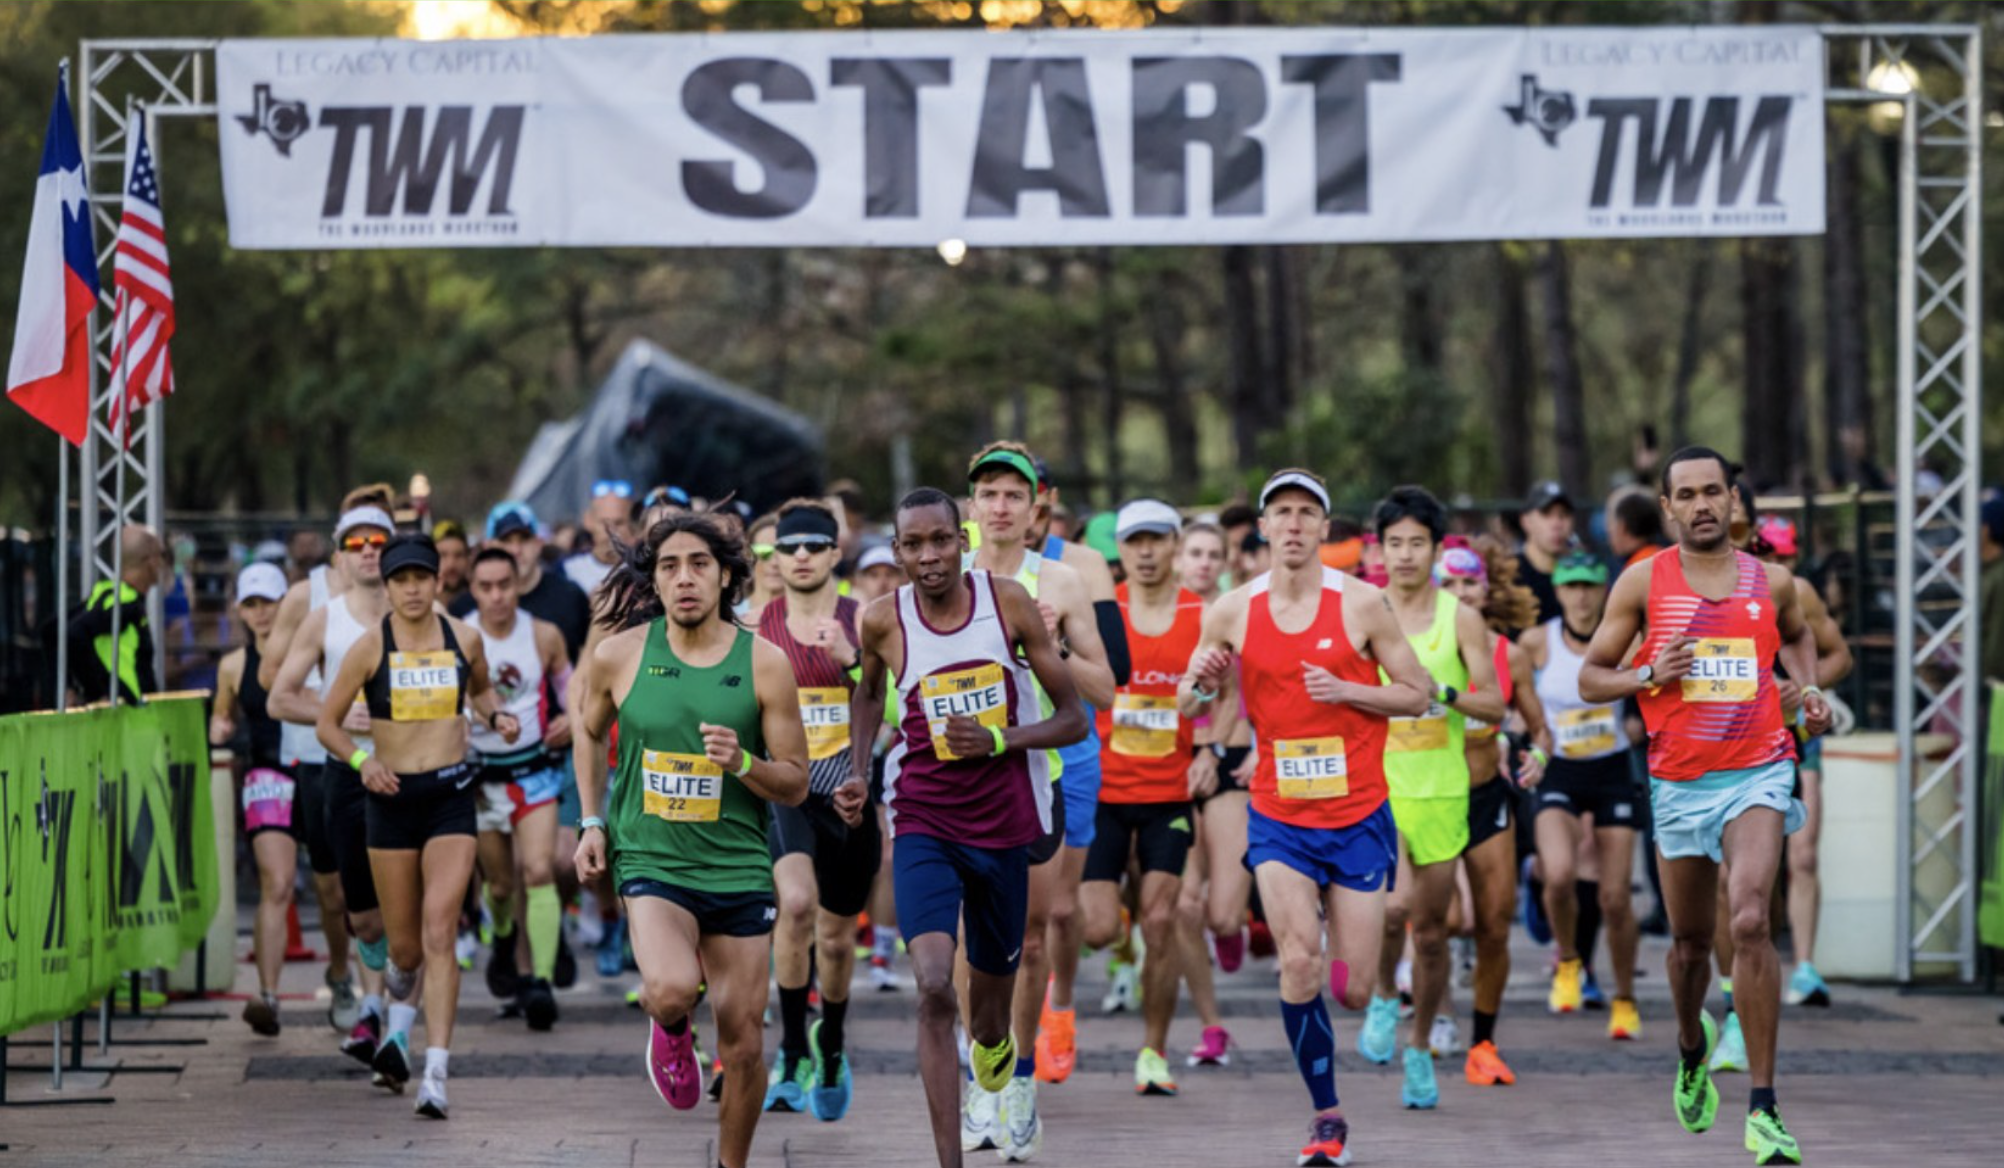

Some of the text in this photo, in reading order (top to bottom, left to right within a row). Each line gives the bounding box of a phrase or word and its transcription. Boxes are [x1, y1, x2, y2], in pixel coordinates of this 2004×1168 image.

[275, 49, 538, 76] LEGACY CAPITAL
[679, 52, 1404, 220] START
[317, 104, 526, 218] TWM
[1586, 95, 1795, 208] TWM
[398, 668, 450, 688] ELITE
[1689, 658, 1749, 678] ELITE
[1710, 679, 1728, 693] 26
[933, 686, 999, 718] ELITE
[1283, 757, 1338, 778] ELITE
[649, 772, 713, 797] ELITE
[667, 796, 687, 811] 22
